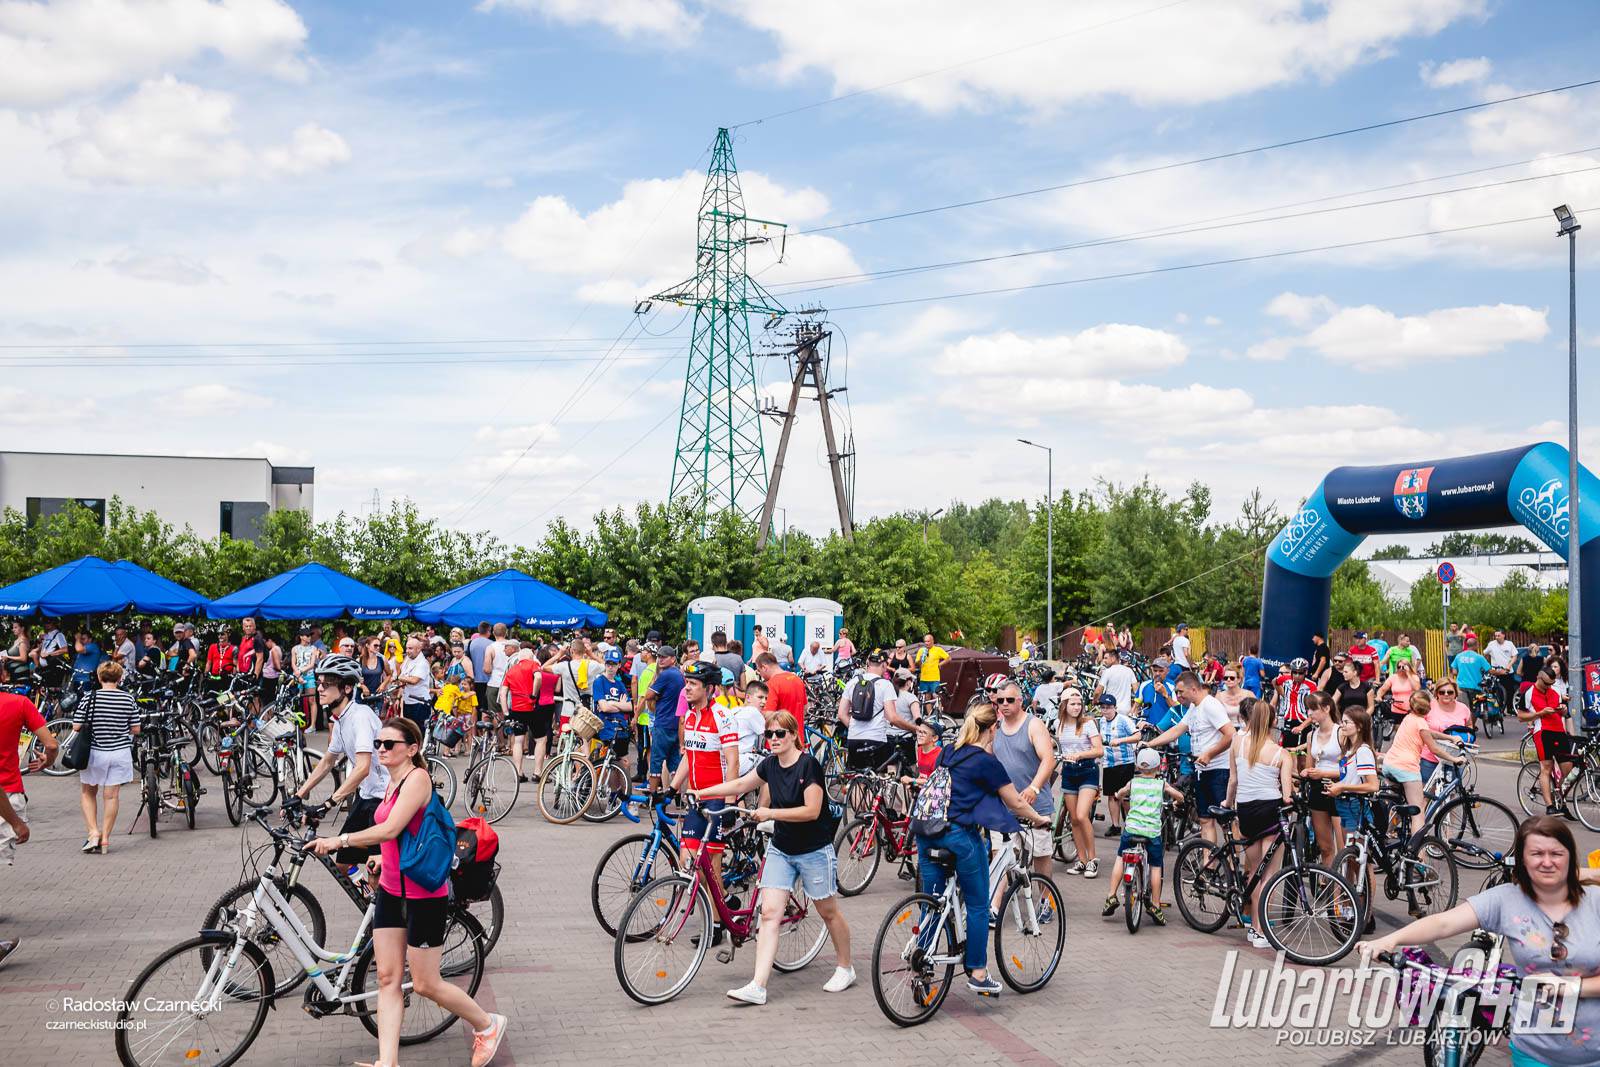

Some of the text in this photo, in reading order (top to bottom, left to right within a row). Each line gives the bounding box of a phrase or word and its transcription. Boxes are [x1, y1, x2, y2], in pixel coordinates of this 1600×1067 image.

[1441, 481, 1495, 496] www.lubartow.pl
[1337, 496, 1380, 505] Miasto Lubartów
[1303, 534, 1330, 561] LEWARTA
